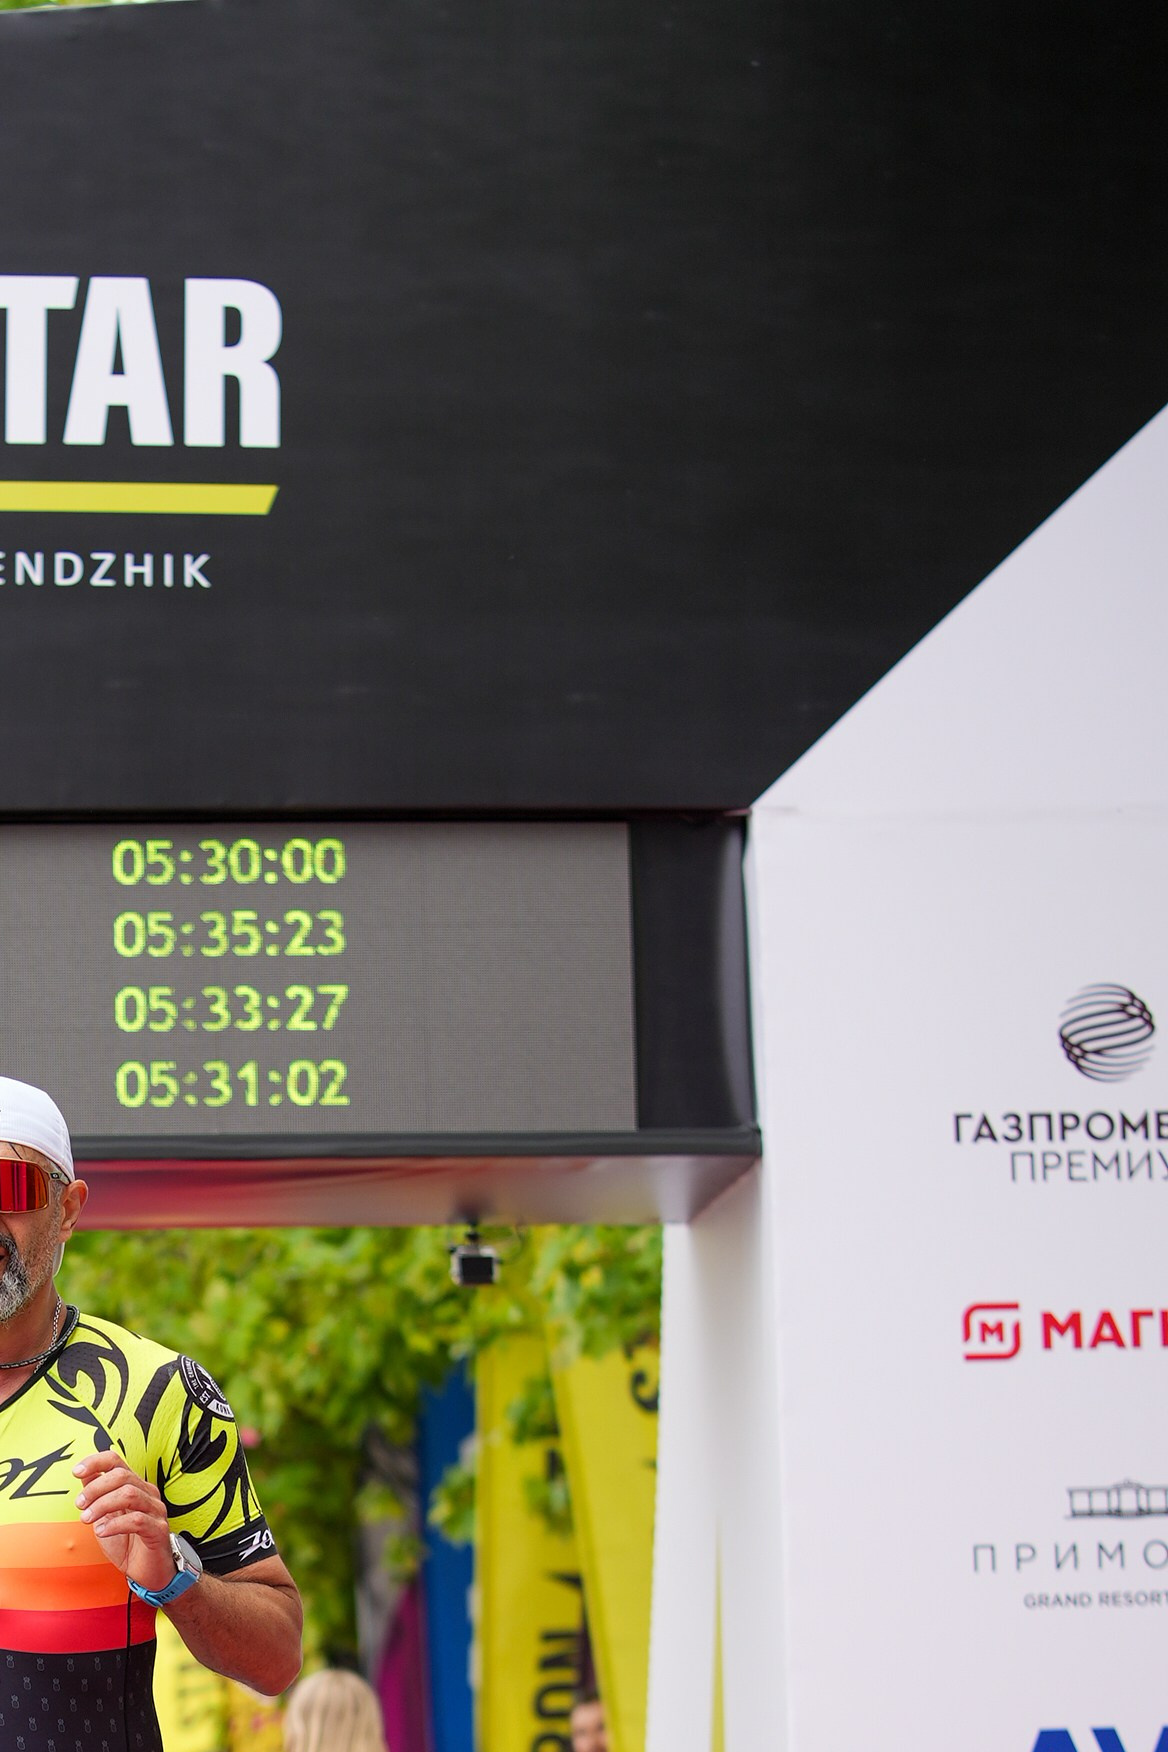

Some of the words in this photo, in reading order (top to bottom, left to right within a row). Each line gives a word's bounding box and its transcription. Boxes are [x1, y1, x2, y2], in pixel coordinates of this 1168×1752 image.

[111, 837, 347, 885] 05:30:00
[113, 909, 347, 958] 05:35:23
[114, 984, 350, 1033] 05:33:27
[115, 1059, 352, 1108] 05:31:02
[1041, 1309, 1168, 1350] МАГ
[1023, 1591, 1093, 1610] GRAND
